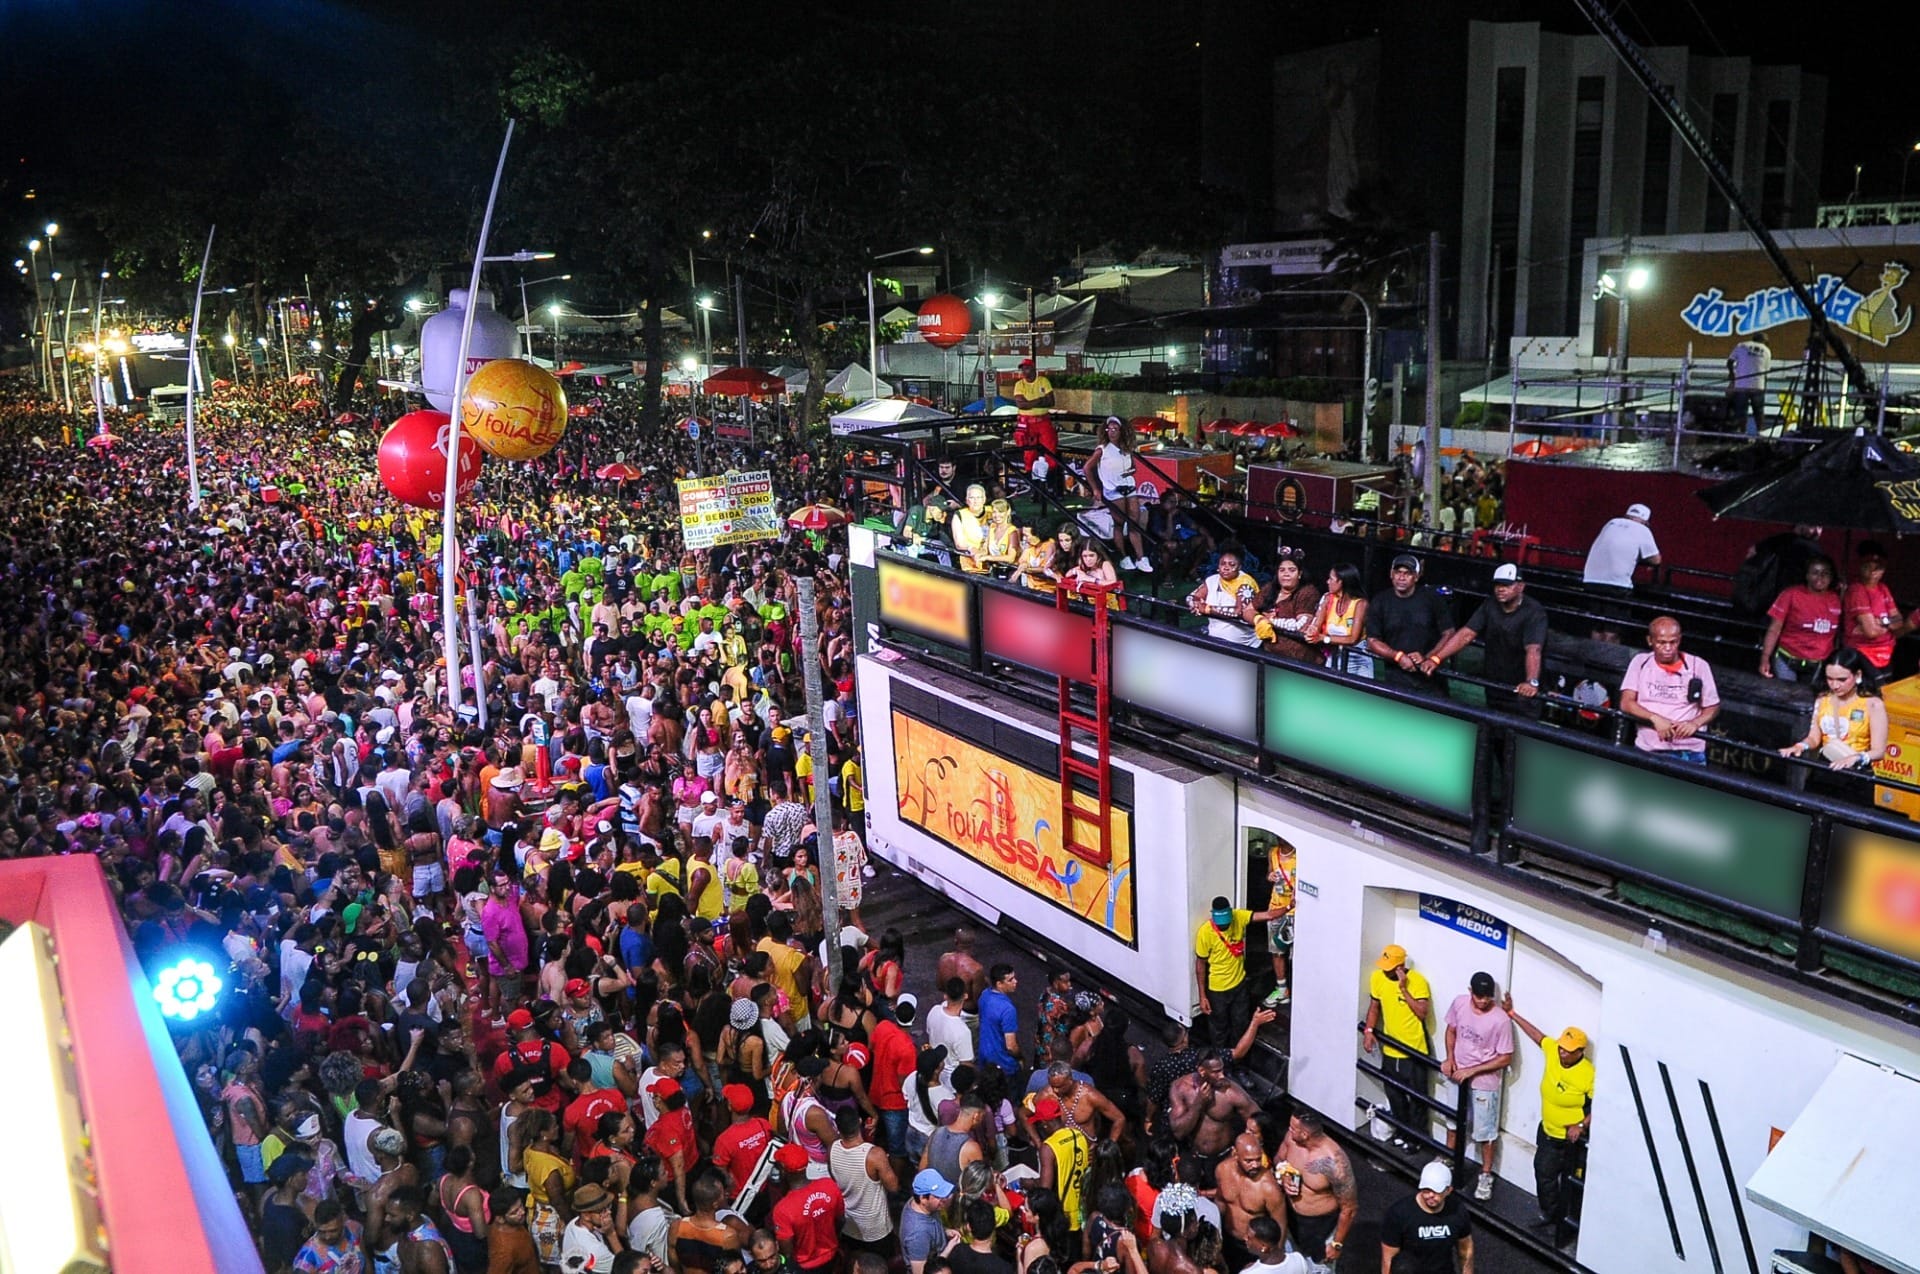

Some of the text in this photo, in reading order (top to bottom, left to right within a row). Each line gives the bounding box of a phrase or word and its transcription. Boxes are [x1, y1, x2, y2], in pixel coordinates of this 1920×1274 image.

[730, 472, 769, 483] MELHOR
[730, 484, 768, 495] DENTRO
[685, 515, 699, 524] OU
[705, 511, 741, 522] BEBIDA
[687, 526, 720, 538] DIRIJA
[715, 532, 754, 544] Santiago
[1456, 903, 1495, 924] POSTO
[738, 1131, 766, 1149] BOMBEIRO
[803, 1191, 831, 1216] BOMBEIRO
[1418, 1224, 1452, 1239] NASA
